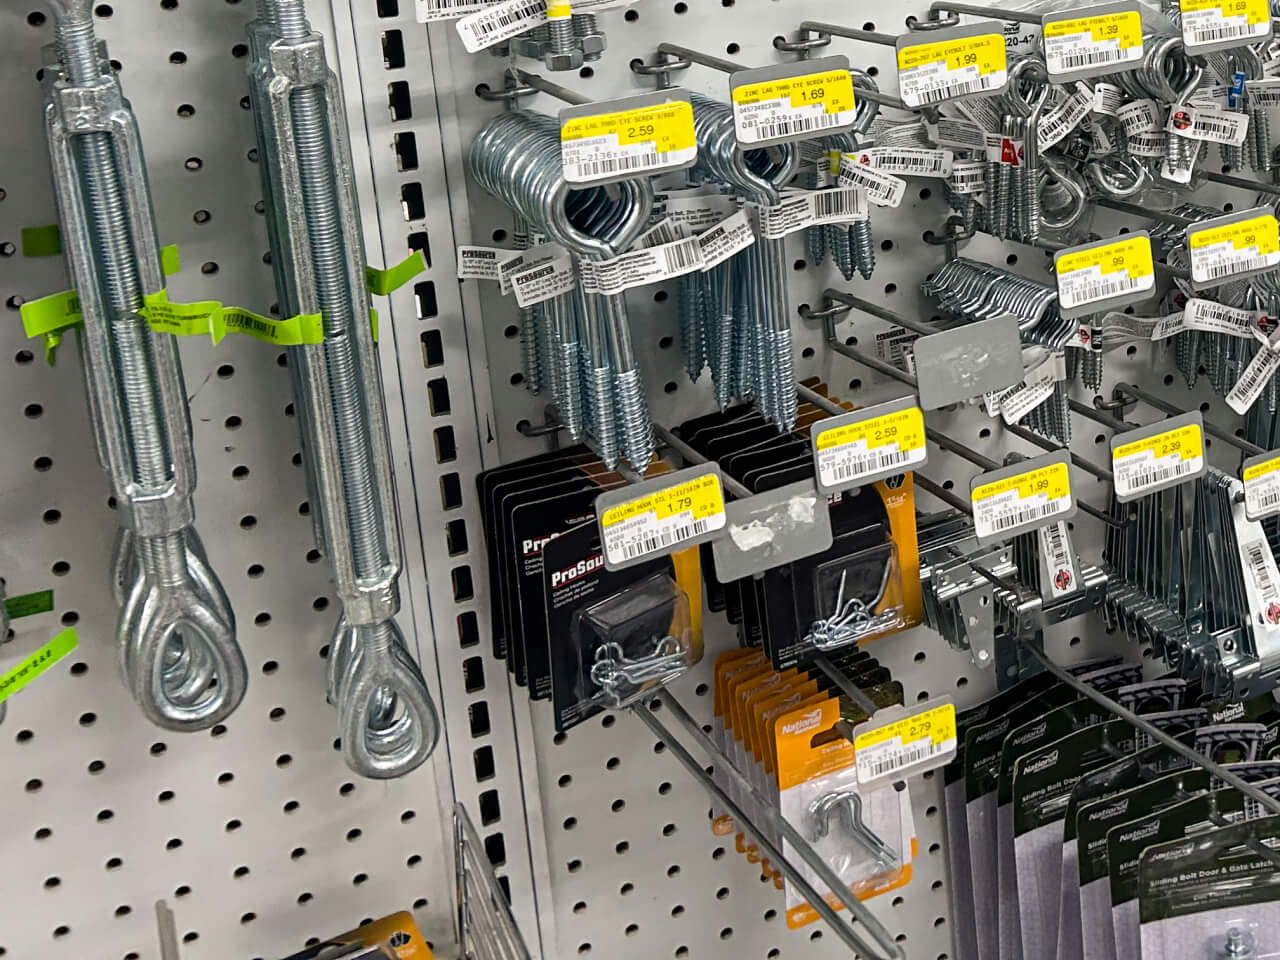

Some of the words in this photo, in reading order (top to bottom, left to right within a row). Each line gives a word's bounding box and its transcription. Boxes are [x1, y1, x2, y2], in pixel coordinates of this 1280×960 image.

[1228, 1, 1246, 12] 1.69
[1099, 25, 1118, 36] 1.39
[1006, 34, 1034, 46] 20-47
[955, 54, 976, 66] 1.99
[801, 88, 824, 101] 1.69
[627, 126, 654, 138] 2.59
[875, 427, 897, 440] 2.59
[1162, 442, 1180, 454] 2.39
[1029, 480, 1049, 493] 1.99
[668, 497, 691, 512] 1.79
[552, 553, 604, 587] ProSou
[782, 714, 822, 734] National
[910, 722, 931, 736] 2.79
[1023, 755, 1058, 775] National
[1089, 803, 1128, 821] National
[1119, 824, 1160, 842] National
[1179, 872, 1197, 881] Bolt
[1198, 869, 1219, 878] Door
[1229, 864, 1248, 873] Gate
